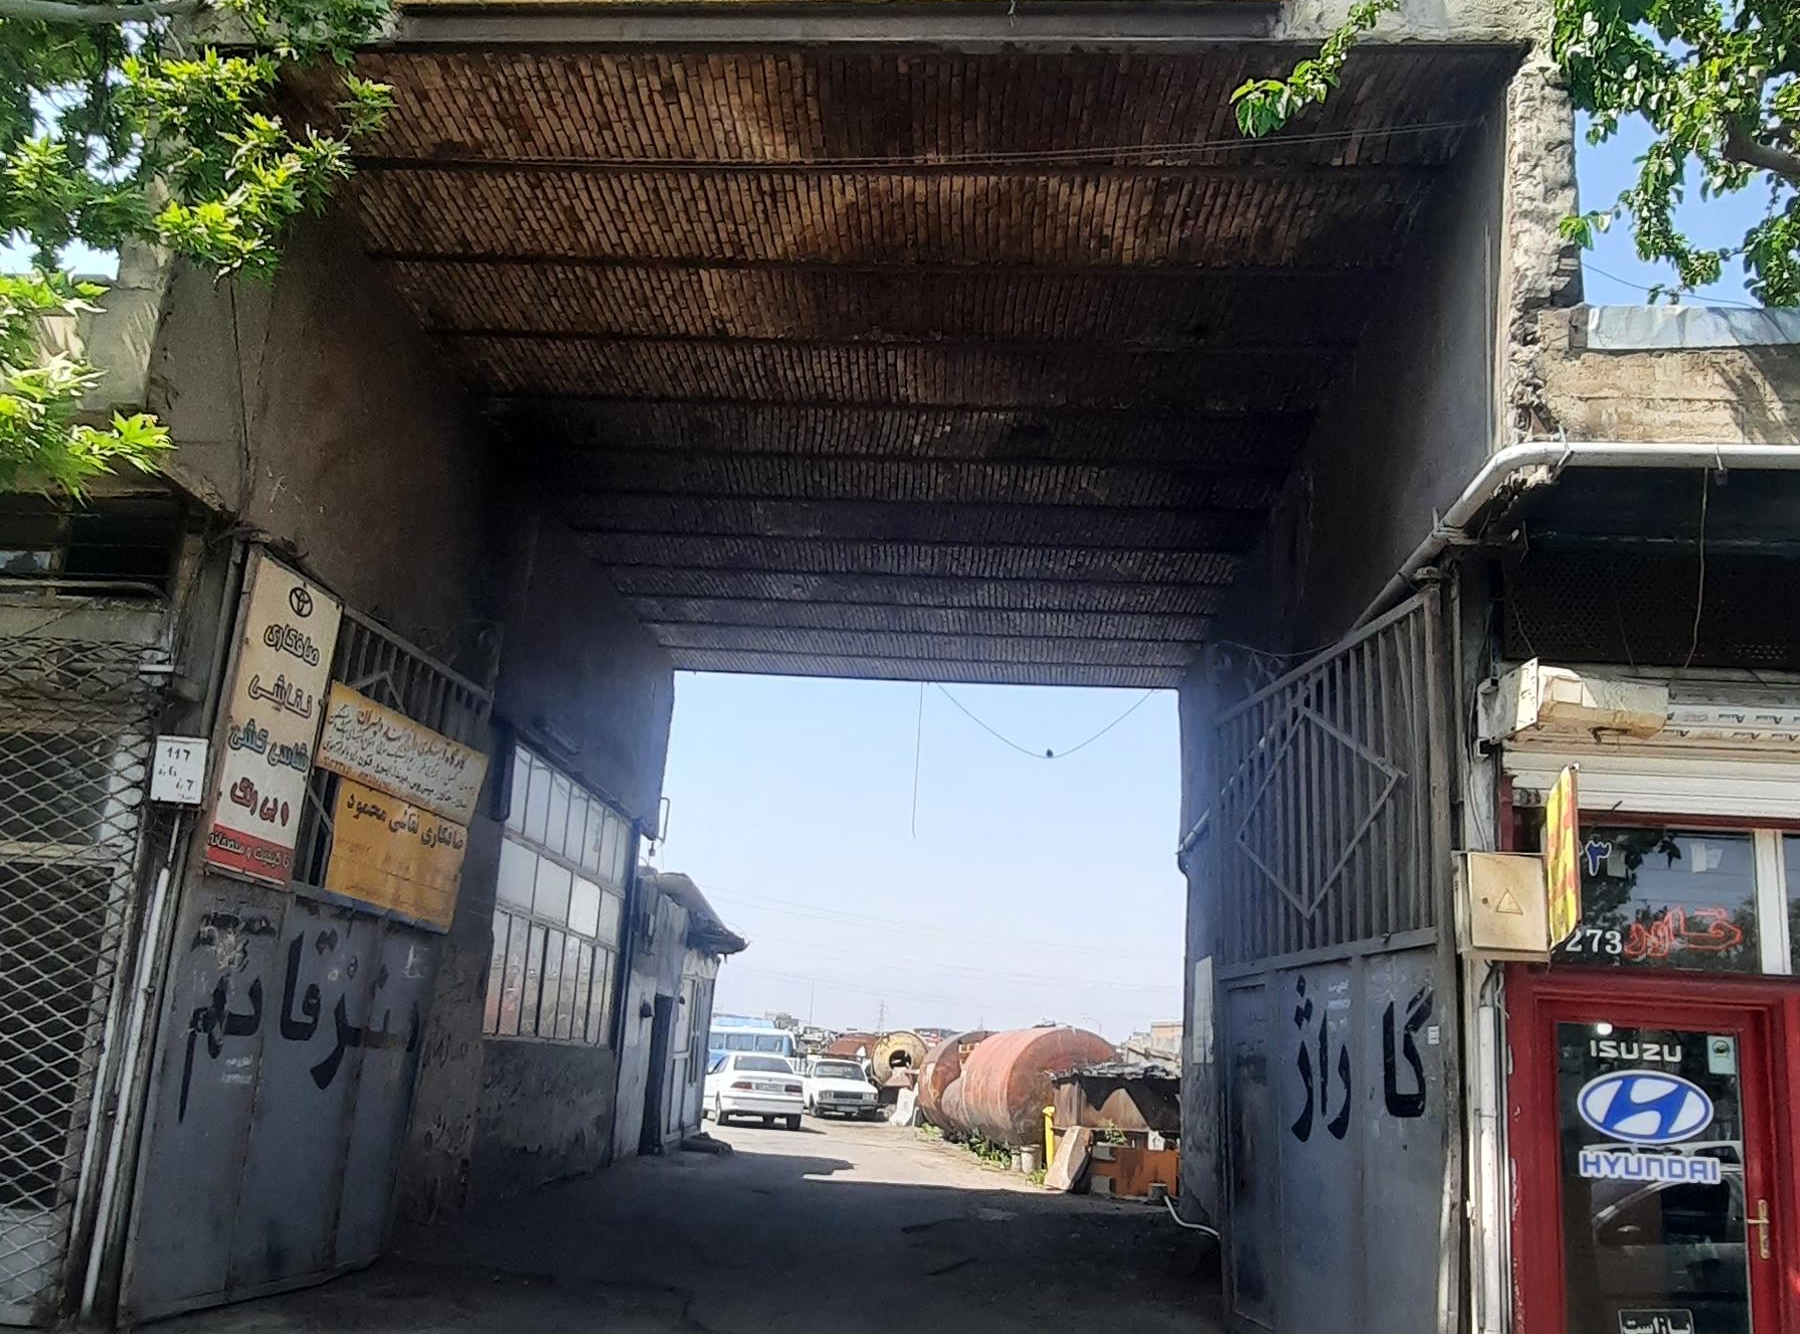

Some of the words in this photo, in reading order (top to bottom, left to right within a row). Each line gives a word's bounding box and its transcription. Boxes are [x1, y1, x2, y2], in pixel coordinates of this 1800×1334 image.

[263, 623, 320, 667] صافکاری
[247, 673, 313, 720] نقاشی
[1565, 928, 1623, 955] 273
[1589, 1039, 1682, 1063] ISUZU
[1581, 1152, 1719, 1182] HYUNDAI
